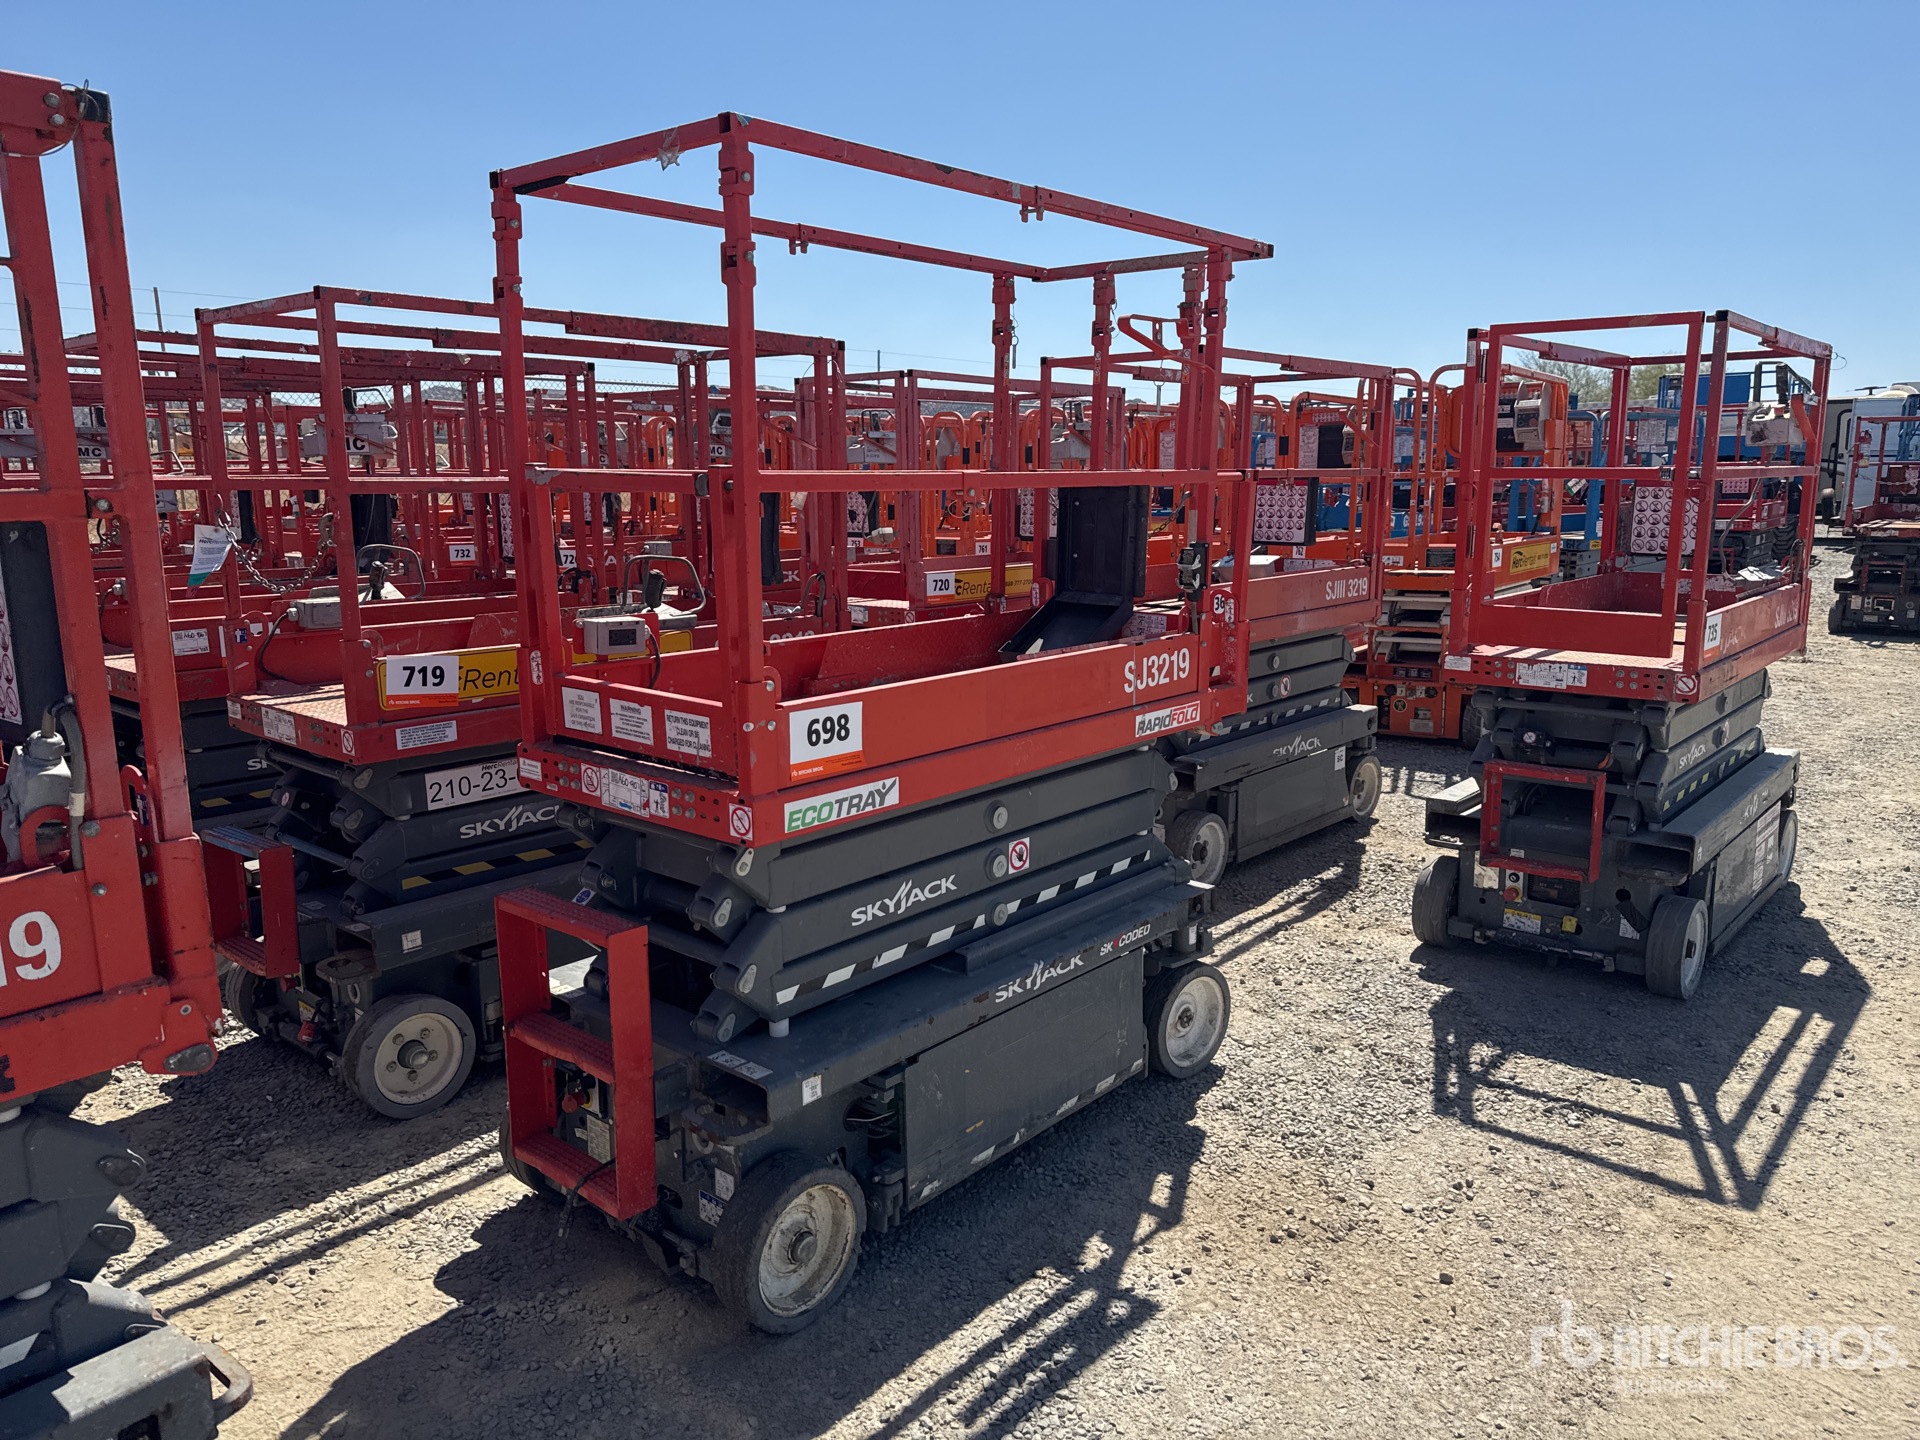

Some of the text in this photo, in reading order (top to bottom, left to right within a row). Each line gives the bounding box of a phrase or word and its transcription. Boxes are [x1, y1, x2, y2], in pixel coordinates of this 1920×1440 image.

[454, 548, 471, 559] 732
[978, 544, 988, 553] 761
[1295, 546, 1304, 556] 762
[932, 578, 950, 592] 720
[1325, 577, 1368, 600] SJIII 3219
[1707, 623, 1718, 643] 735
[402, 665, 445, 688] 719
[1123, 647, 1190, 694] SJ3219
[689, 718, 709, 729] EQUIPMENT
[806, 713, 851, 747] 698
[1679, 743, 1707, 770] SKYJACK
[786, 777, 898, 832] ECOTRAY
[850, 874, 959, 927] SKYJACK
[994, 954, 1085, 1003] SKYJACK
